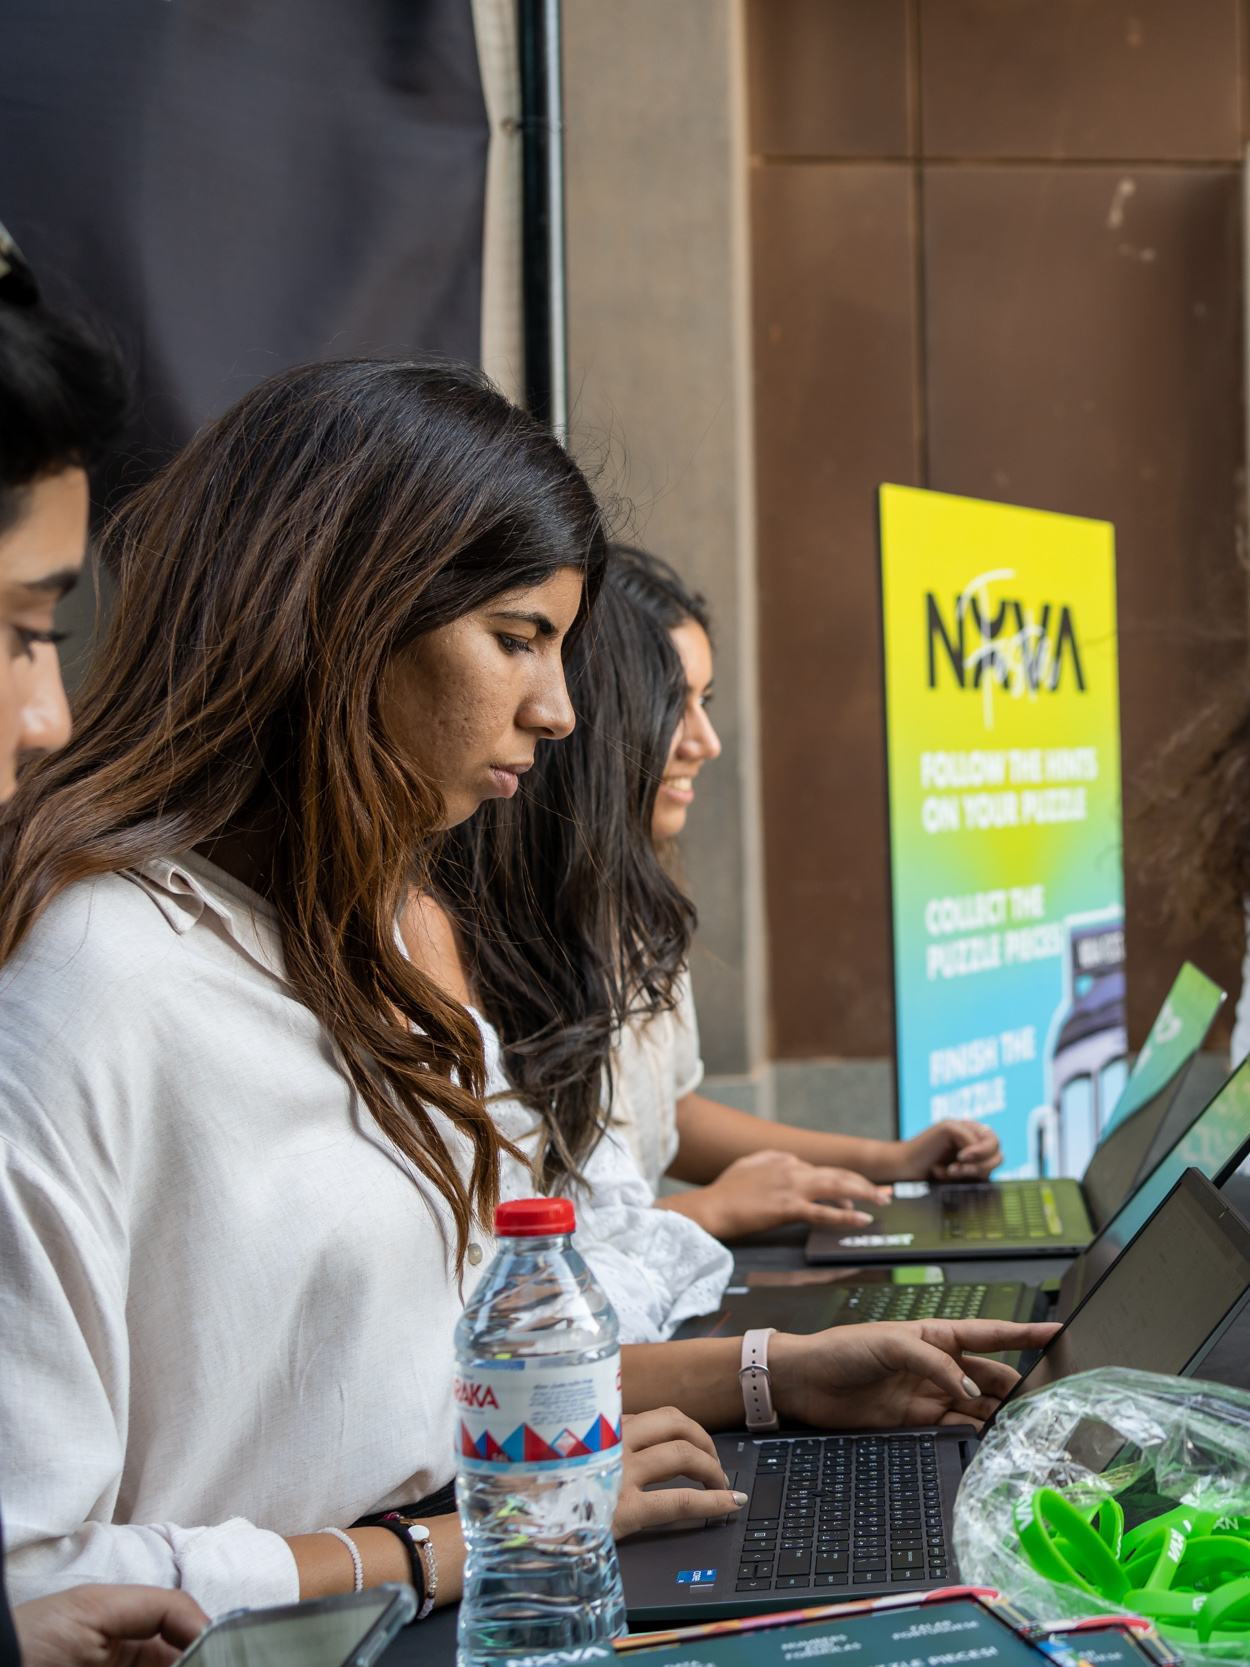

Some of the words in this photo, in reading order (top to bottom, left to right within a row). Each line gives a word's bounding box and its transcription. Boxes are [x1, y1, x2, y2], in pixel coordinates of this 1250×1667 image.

[920, 749, 1006, 788] FOLLOW
[1006, 748, 1044, 784] THE
[1046, 746, 1098, 782] HINTS
[921, 794, 960, 834] ON
[962, 790, 1021, 830] YOUR
[1022, 787, 1088, 825] PUZZLE
[925, 887, 1006, 936] COLLECT
[1007, 884, 1045, 920] THE
[926, 934, 1001, 982] PUZZLE
[929, 1035, 998, 1088] FINISH
[999, 1025, 1038, 1066] THE
